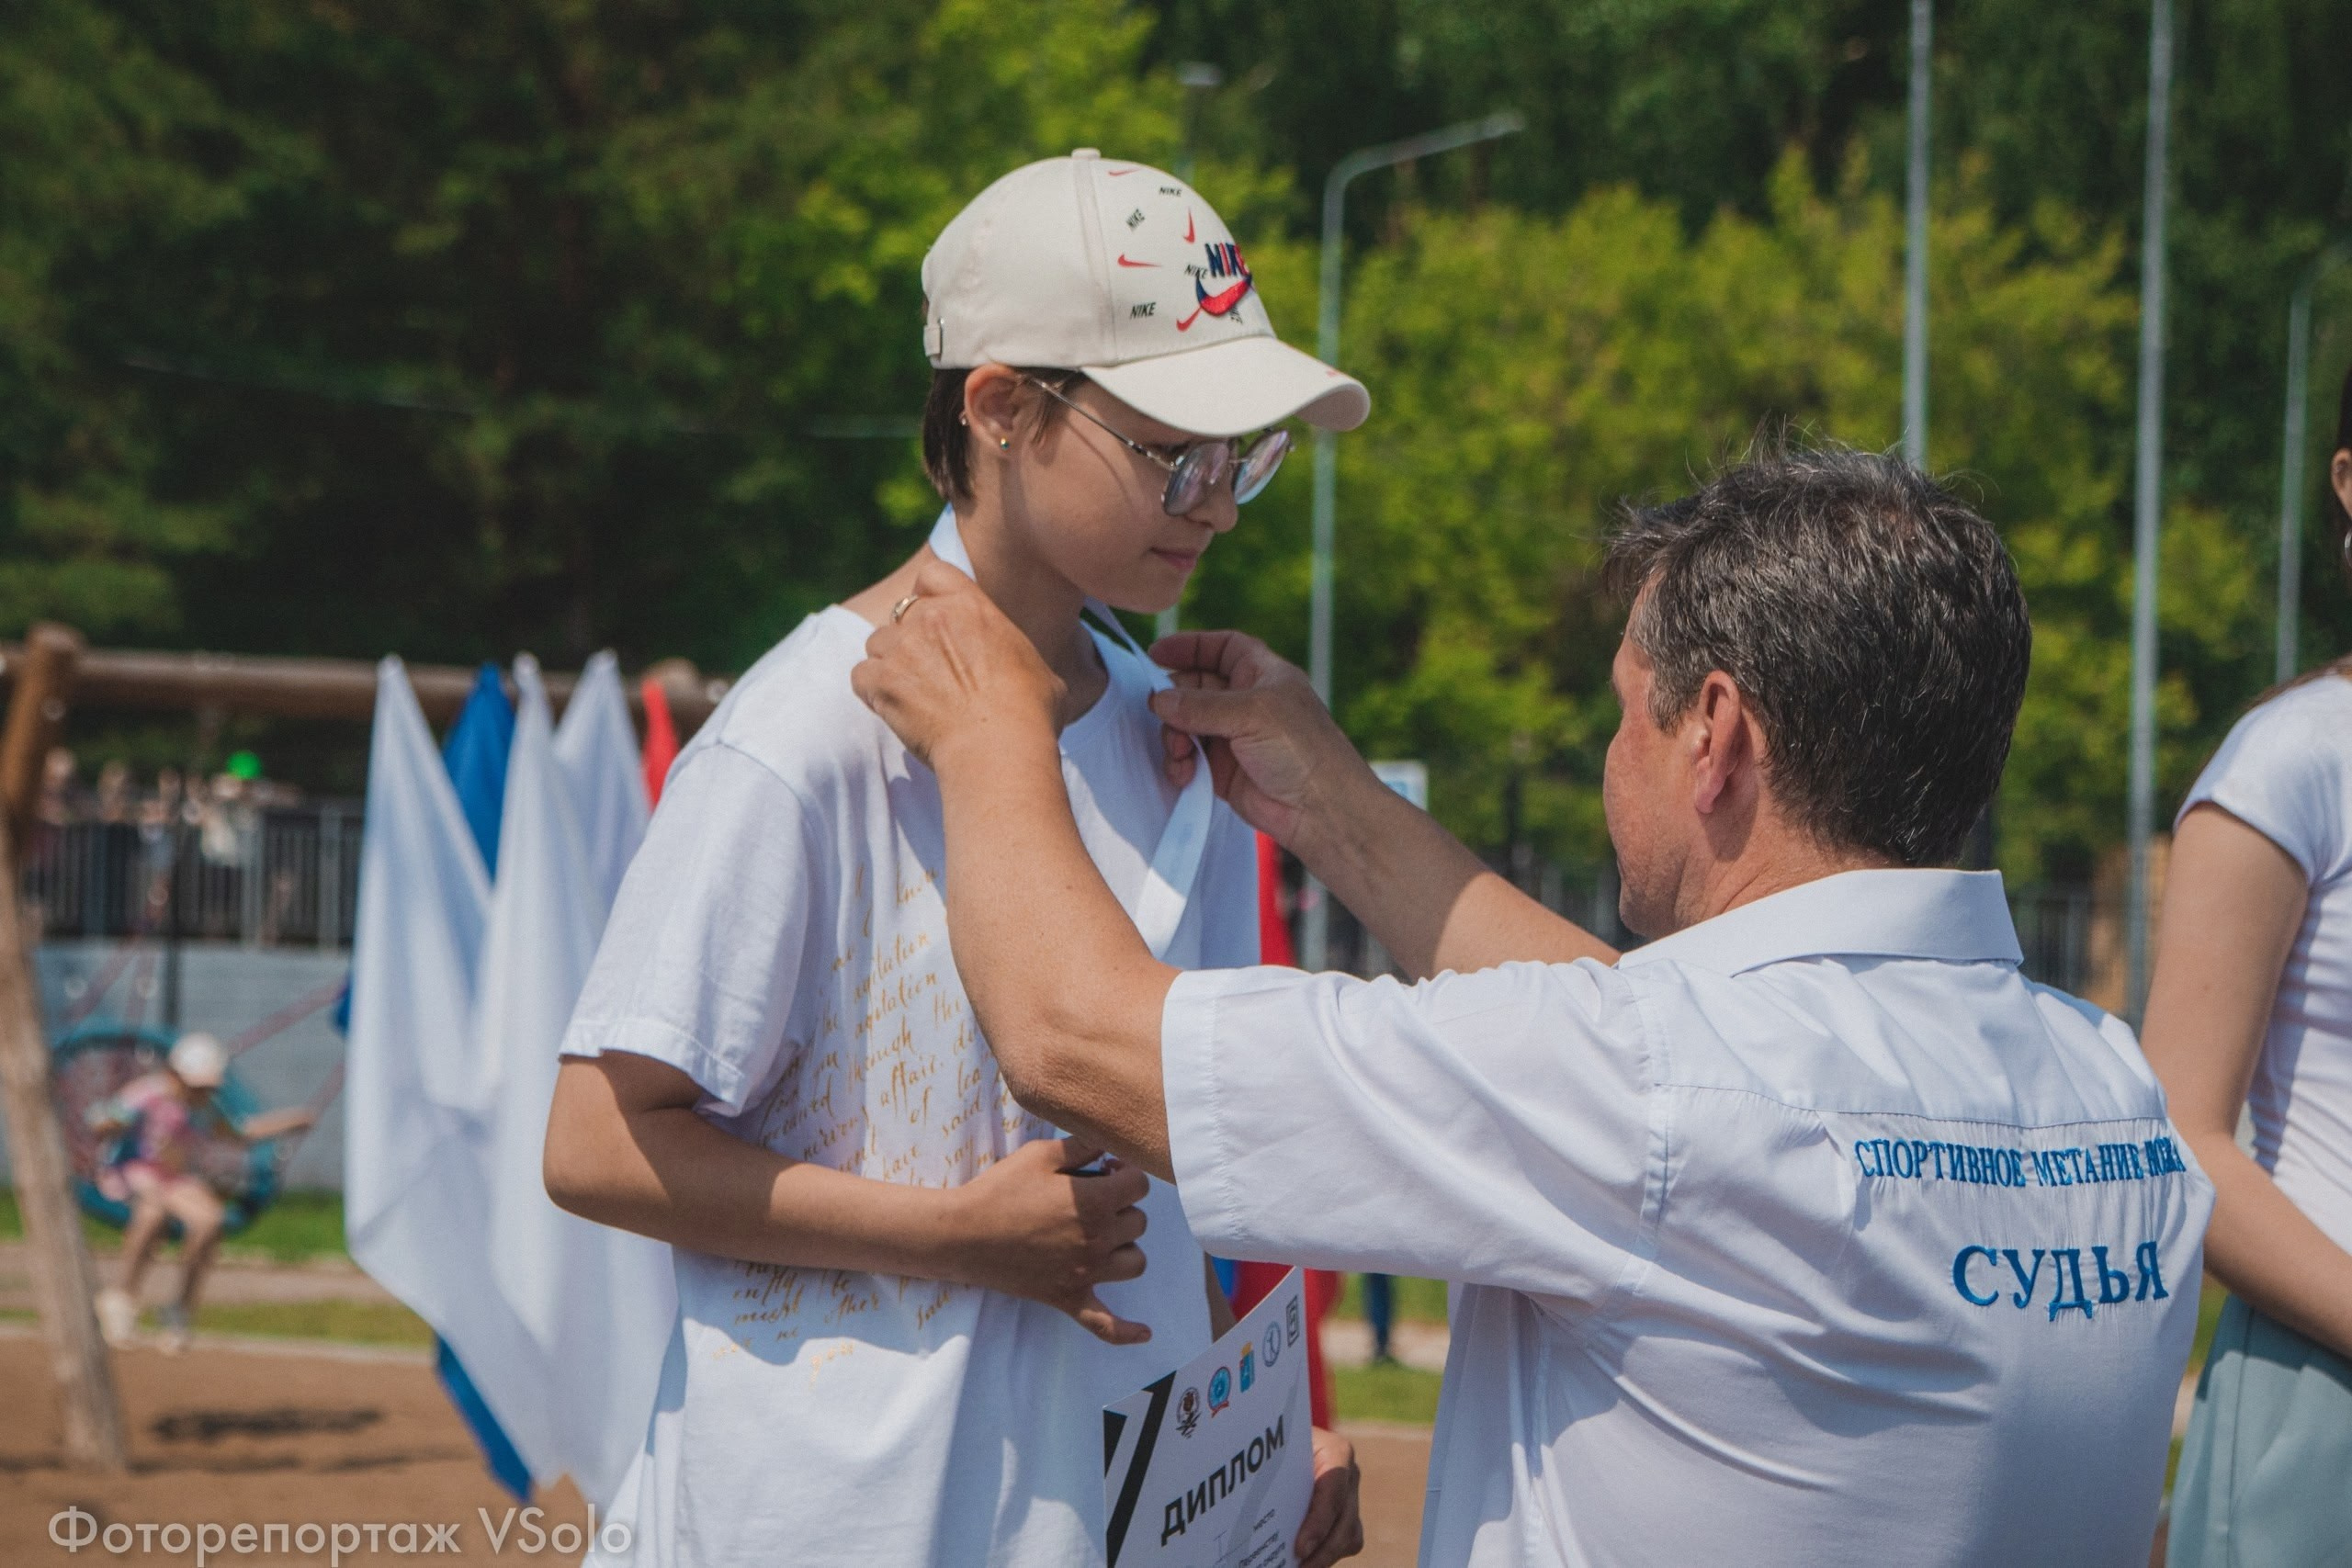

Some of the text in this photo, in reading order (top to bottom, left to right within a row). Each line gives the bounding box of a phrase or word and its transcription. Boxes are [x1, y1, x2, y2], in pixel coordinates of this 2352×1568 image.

[1159, 186, 1182, 197] NIKE
[1125, 209, 1146, 231] NIKE
[1130, 302, 1156, 319] NIKE
[1854, 1138, 2026, 1188] СПОРТИВНОЕ
[2031, 1143, 2144, 1188] МЕТАНИЕ
[1952, 1241, 2169, 1322] СУДЬЯ
[1160, 1415, 1285, 1548] ДИПЛОМ
